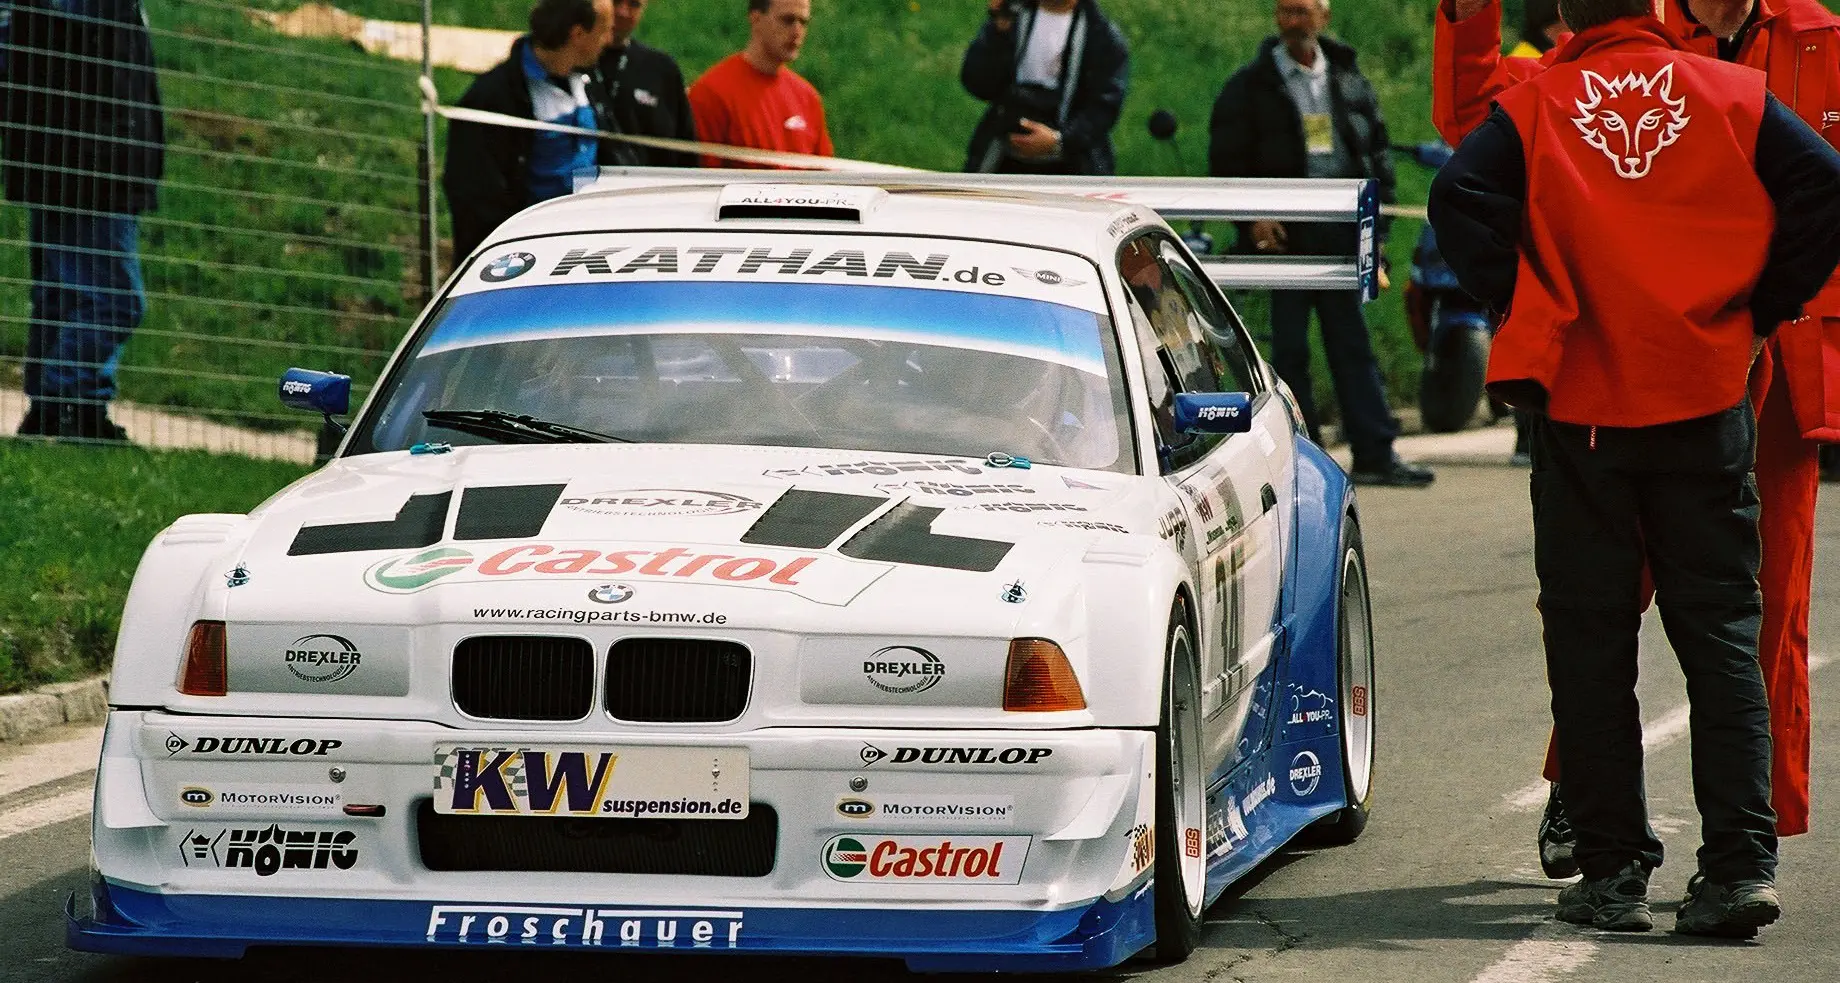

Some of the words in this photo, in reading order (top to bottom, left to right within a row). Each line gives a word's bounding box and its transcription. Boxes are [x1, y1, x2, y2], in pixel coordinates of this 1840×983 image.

[549, 246, 1006, 286] KATHAN.de
[1035, 272, 1061, 283] MINI
[560, 498, 764, 509] DREXLER
[477, 545, 819, 586] Castrol
[473, 608, 728, 624] www.racingparts-bmw.de
[285, 650, 361, 666] DREXLER
[863, 662, 946, 677] DREXLER
[192, 737, 343, 756] DUNLOP
[890, 747, 1053, 764] DUNLOP
[451, 750, 616, 813] KW
[1290, 765, 1321, 782] DREXLER
[602, 797, 742, 818] suspension.de
[1186, 828, 1200, 858] BBS
[869, 841, 1004, 877] Castrol
[427, 905, 744, 942] Froschauer
